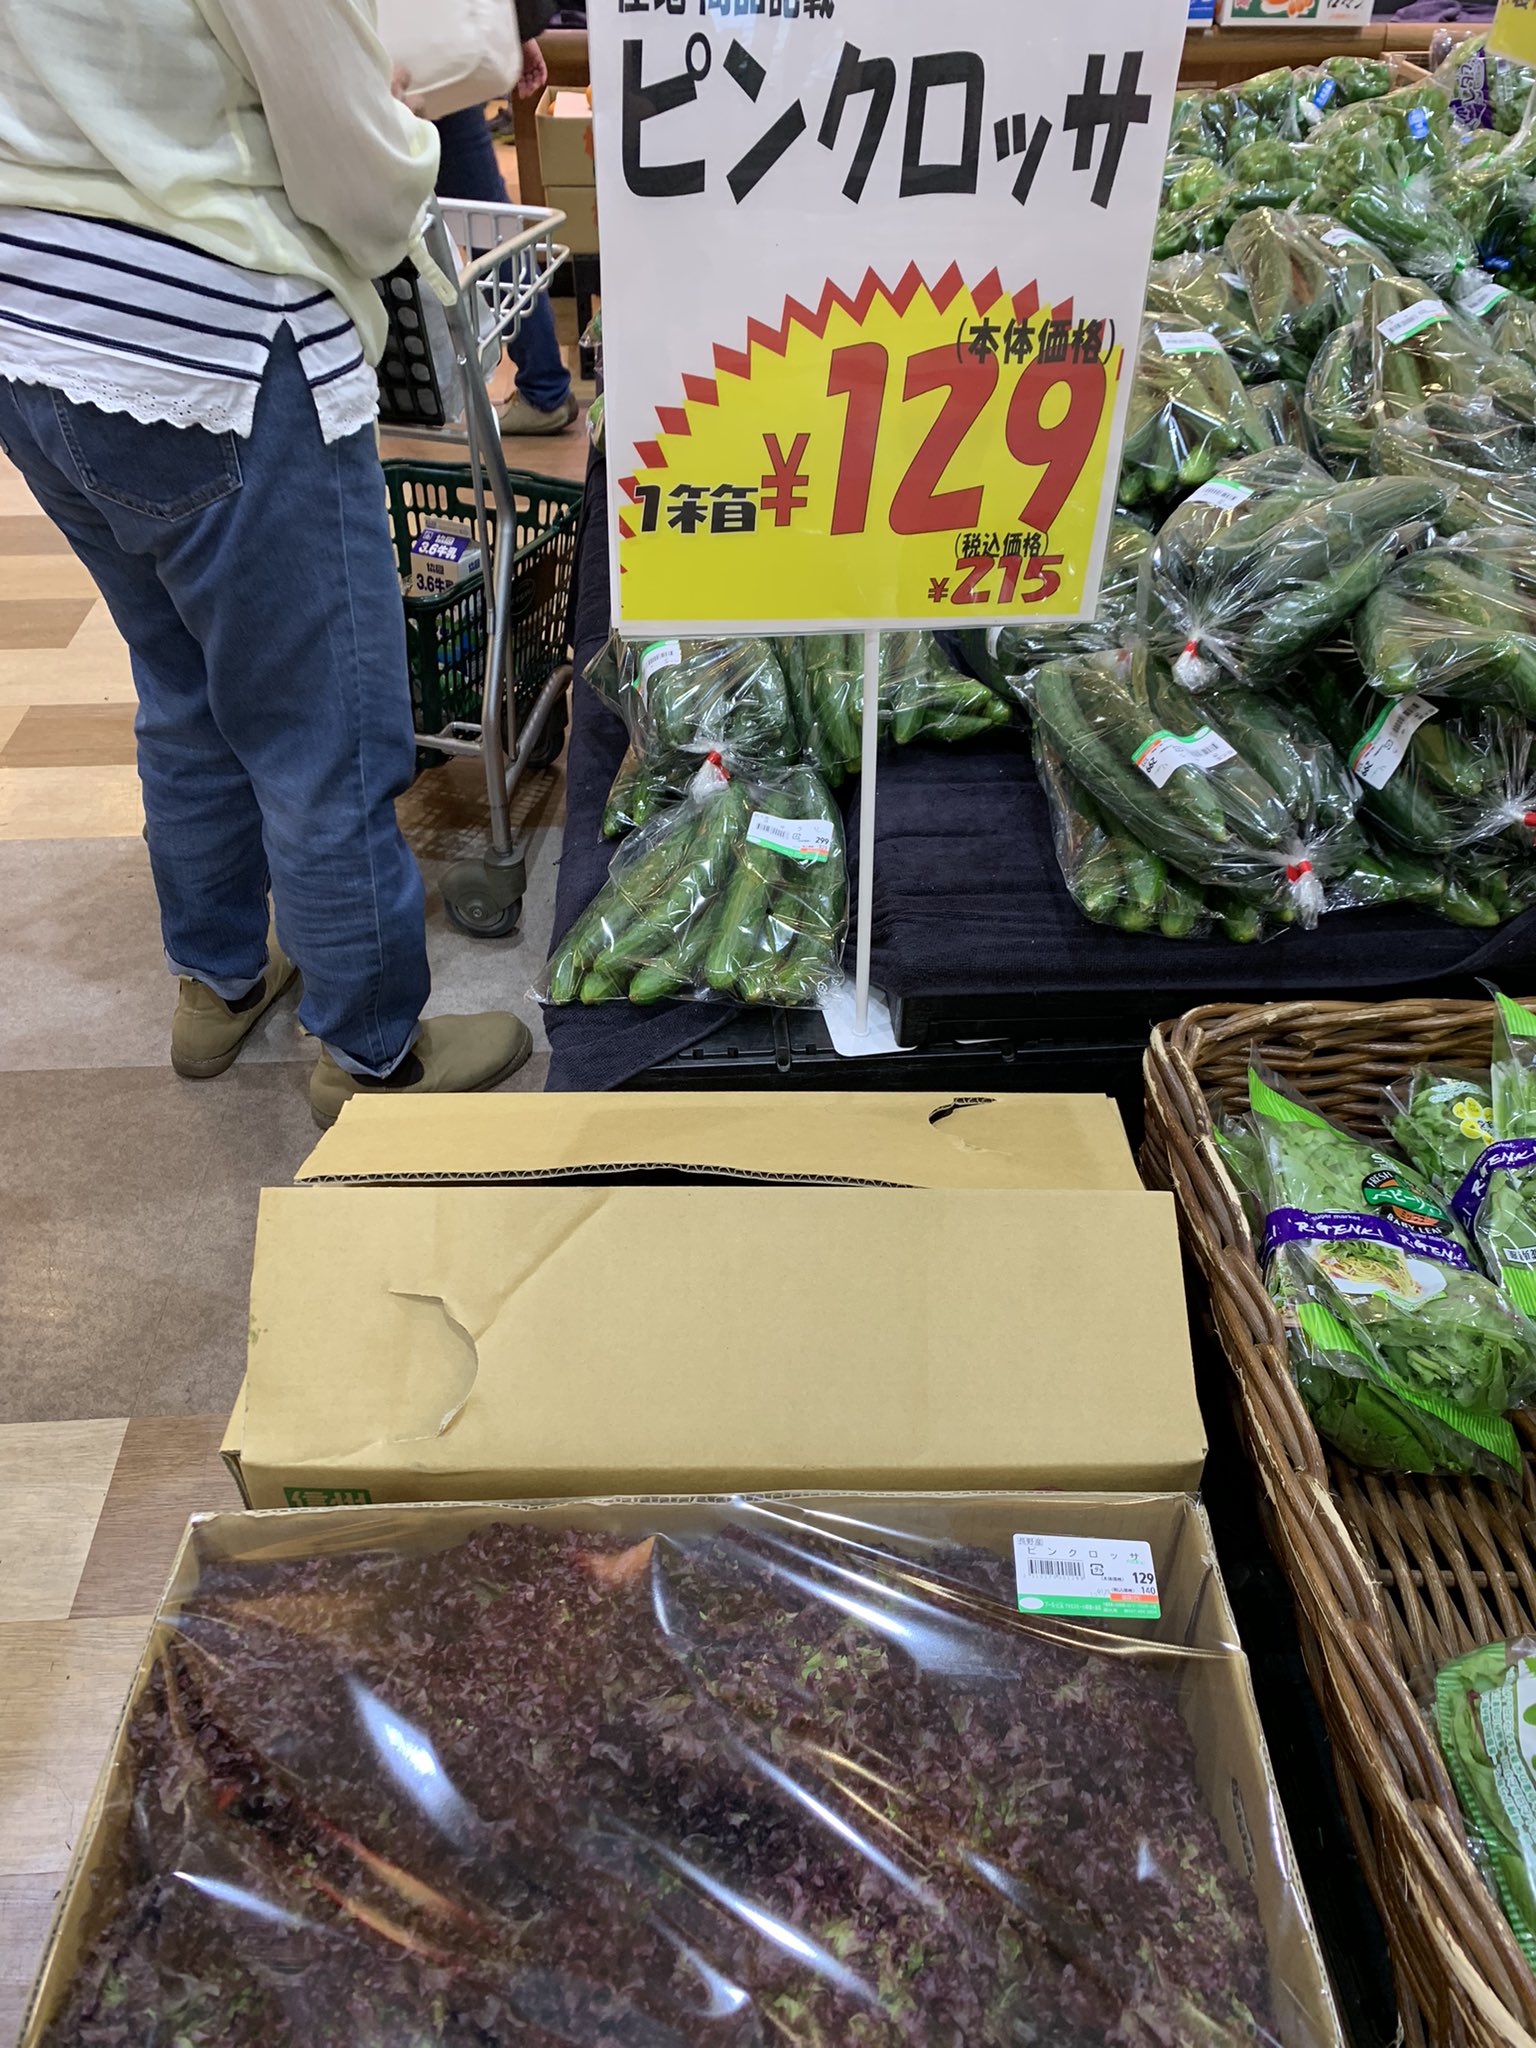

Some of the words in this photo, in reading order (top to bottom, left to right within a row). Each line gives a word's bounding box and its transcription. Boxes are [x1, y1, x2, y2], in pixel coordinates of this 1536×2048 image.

[621, 32, 1151, 209] ピンクロッサ
[1366, 1171, 1394, 1188] FRESH
[1132, 1572, 1155, 1585] 129
